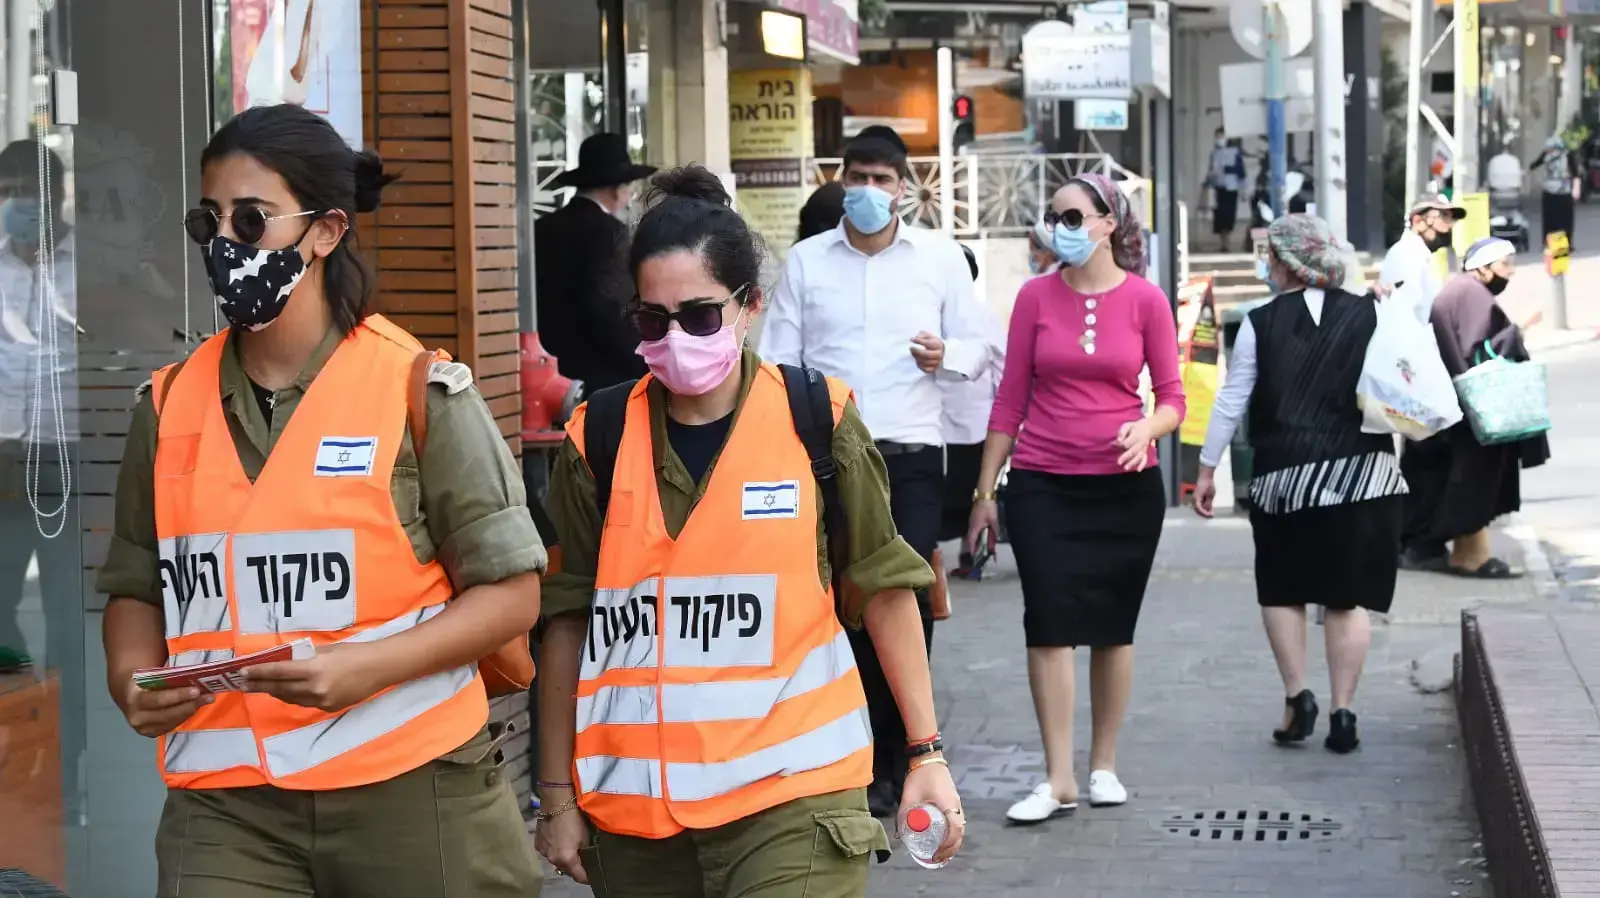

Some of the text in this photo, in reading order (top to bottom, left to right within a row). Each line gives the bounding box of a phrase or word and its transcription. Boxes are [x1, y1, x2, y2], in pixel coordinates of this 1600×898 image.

[759, 80, 794, 98] בית
[731, 103, 795, 120] הוראה
[158, 552, 351, 618] פיקוד העוף
[671, 593, 762, 653] פיקוד
